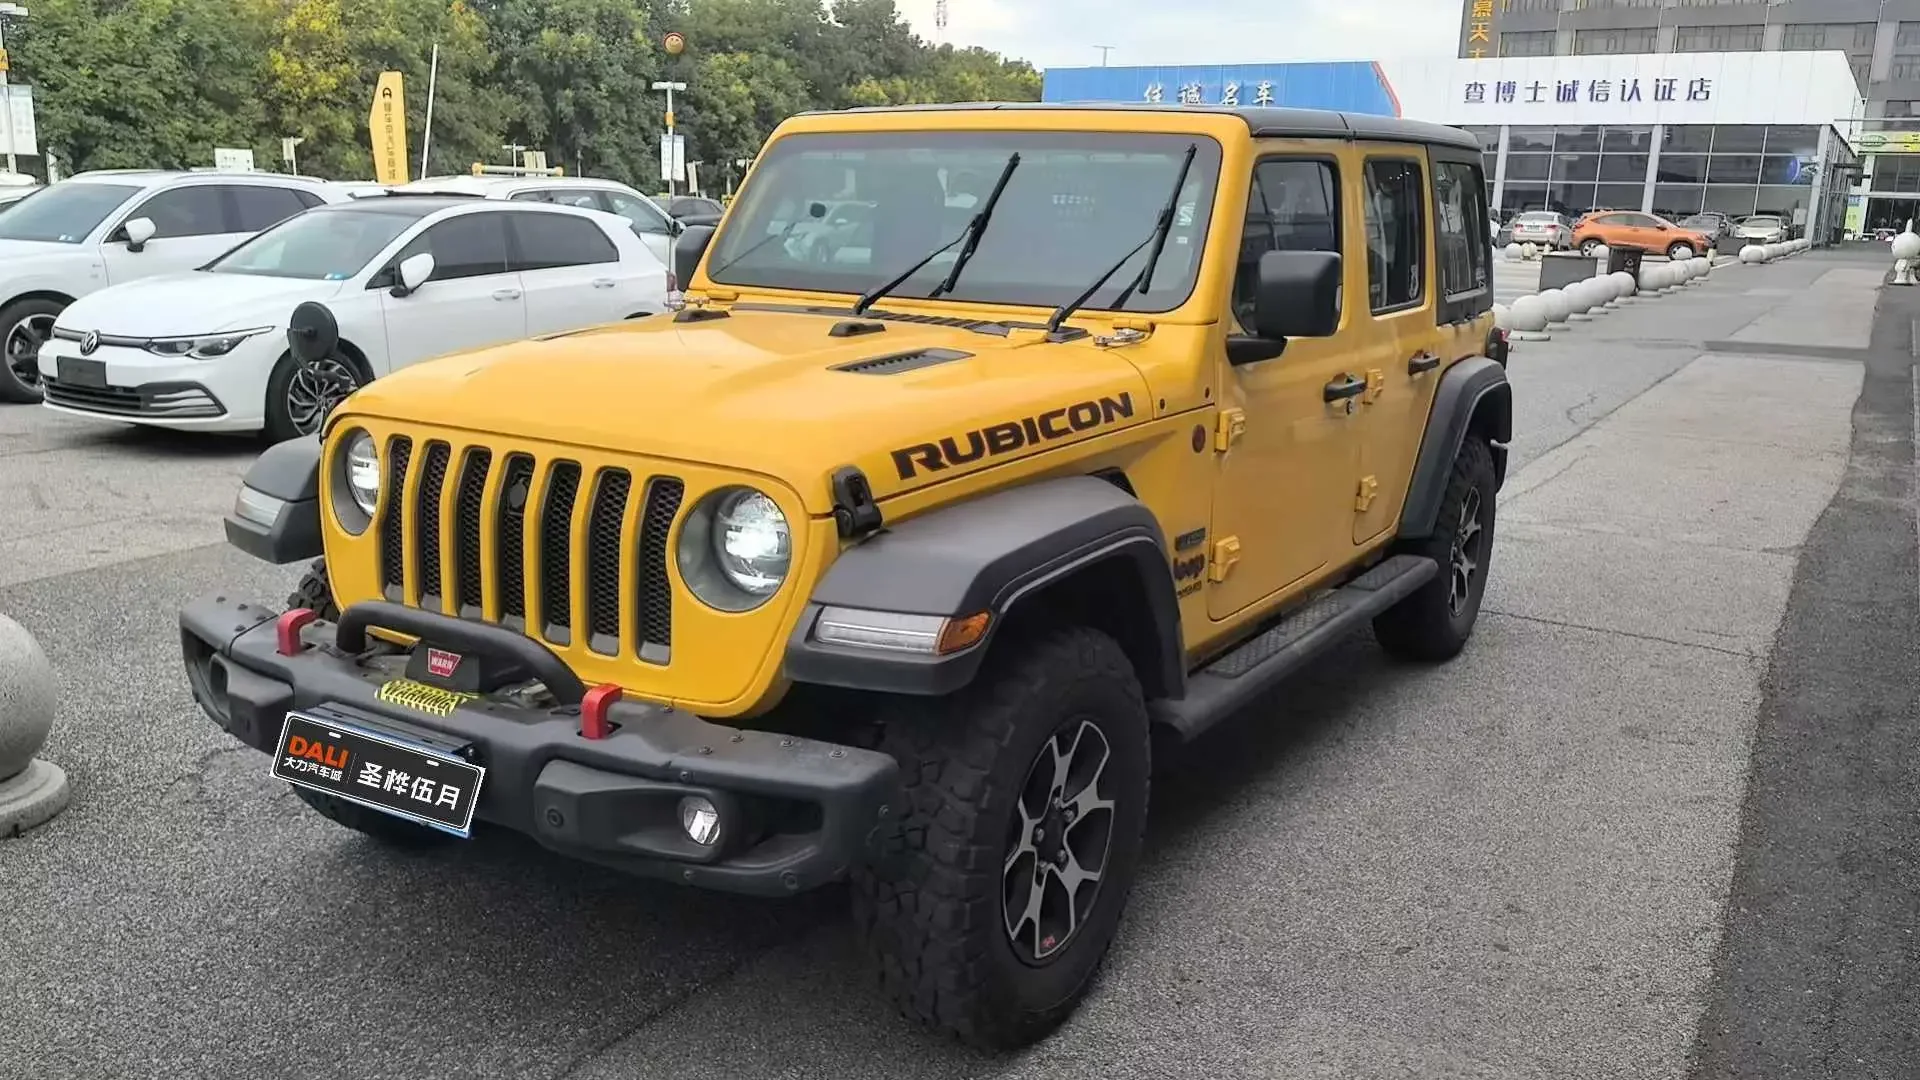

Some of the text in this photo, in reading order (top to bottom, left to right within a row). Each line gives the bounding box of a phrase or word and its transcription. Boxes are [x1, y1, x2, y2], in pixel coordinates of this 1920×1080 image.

[1464, 78, 1713, 104] 查博士诚信认证店
[890, 392, 1133, 480] RUBICON
[431, 656, 453, 670] WARN
